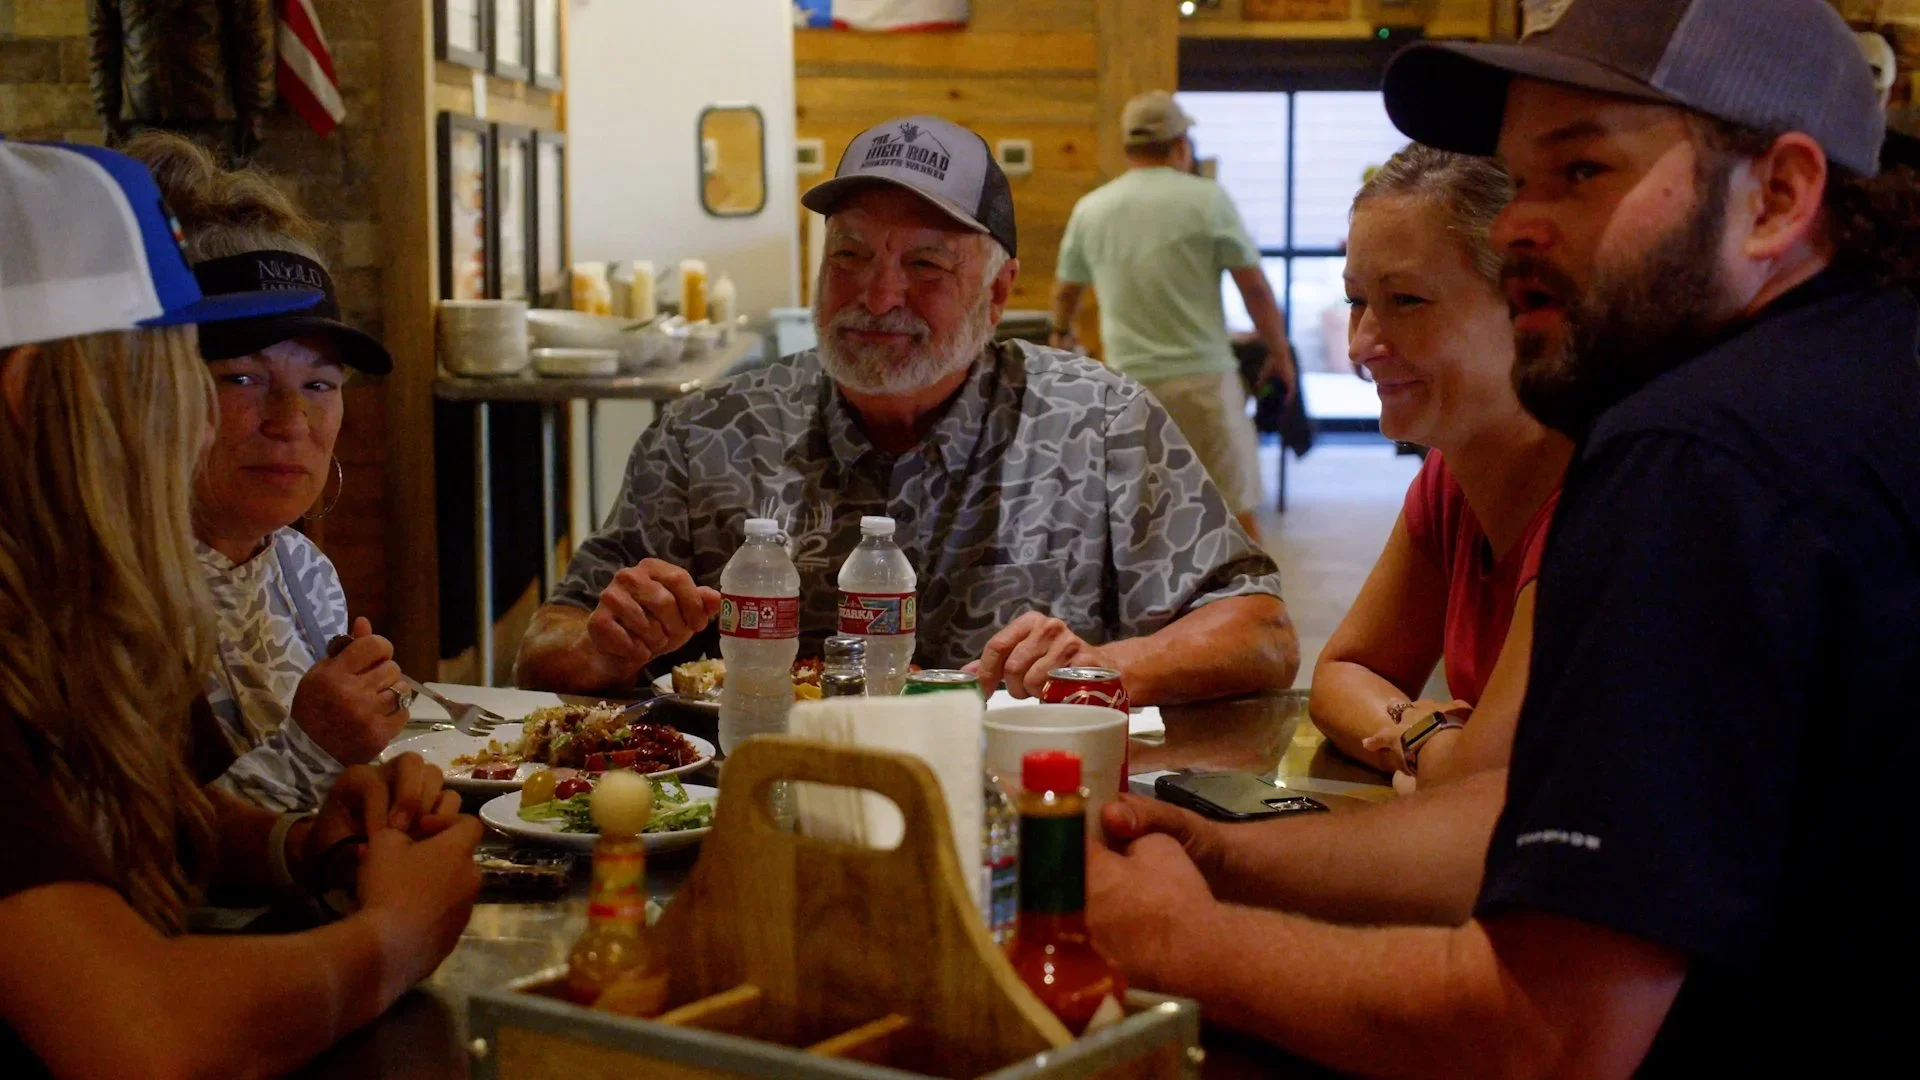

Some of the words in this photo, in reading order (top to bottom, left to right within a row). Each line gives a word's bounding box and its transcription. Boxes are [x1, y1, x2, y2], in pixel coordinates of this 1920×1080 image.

[871, 133, 890, 146] THE
[865, 143, 905, 160] HIGH
[905, 144, 950, 171] ROAD
[838, 607, 875, 620] ZARKA
